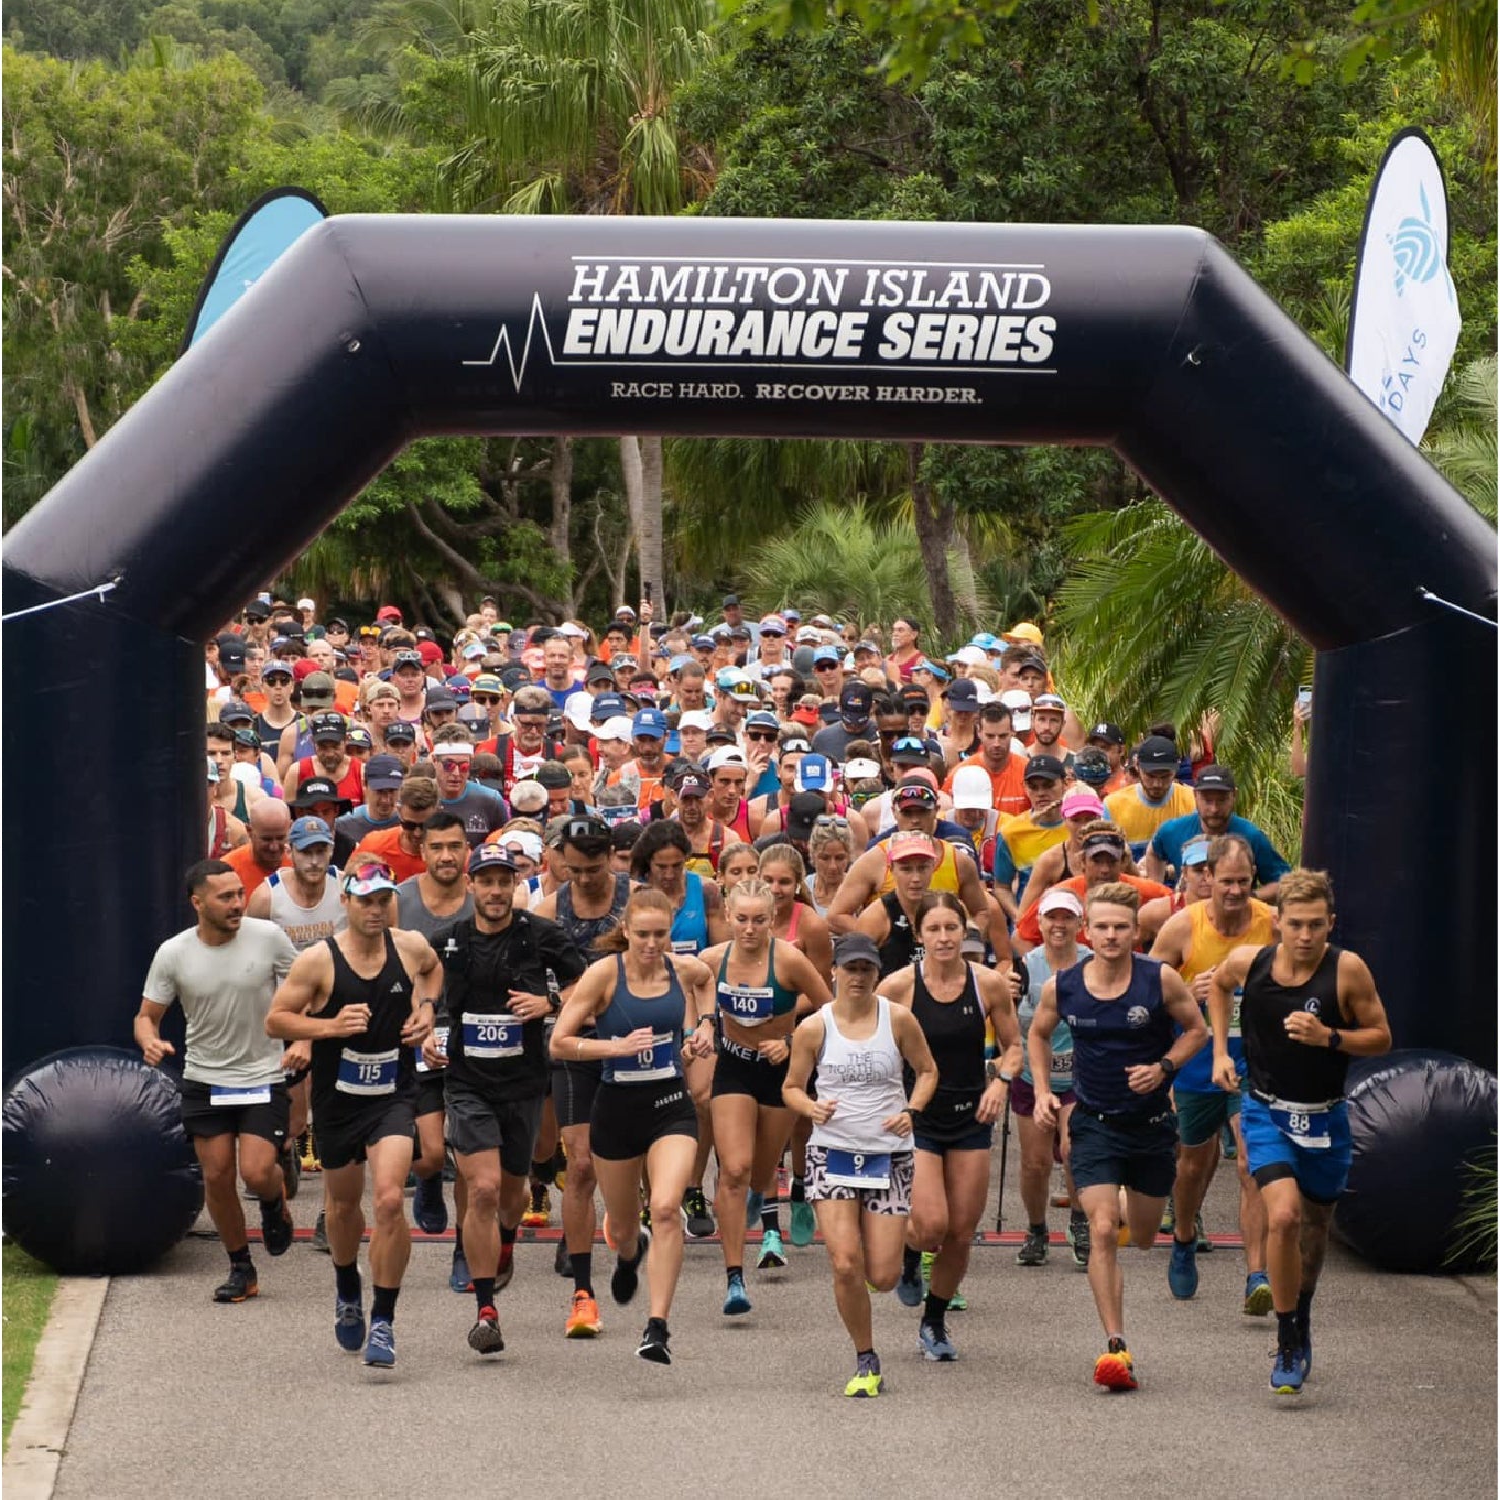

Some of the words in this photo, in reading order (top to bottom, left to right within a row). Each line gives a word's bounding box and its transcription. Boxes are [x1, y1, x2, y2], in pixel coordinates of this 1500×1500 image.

[568, 265, 848, 306] HAMILTON
[859, 270, 1051, 310] ISLAND
[562, 308, 873, 358] ENDURANCE
[877, 314, 1057, 363] SERIES
[1388, 328, 1427, 412] DAYS
[610, 382, 673, 398] RACE
[679, 383, 744, 399] HARD.
[756, 384, 871, 401] RECOVER
[876, 386, 984, 404] HARDER.
[731, 996, 758, 1013] 140
[477, 1026, 509, 1041] 206
[722, 1037, 752, 1060] NIKE
[847, 1052, 871, 1063] THE
[358, 1064, 381, 1080] 115
[828, 1063, 873, 1074] NORTH
[1289, 1113, 1311, 1131] 88
[853, 1154, 865, 1170] 9
